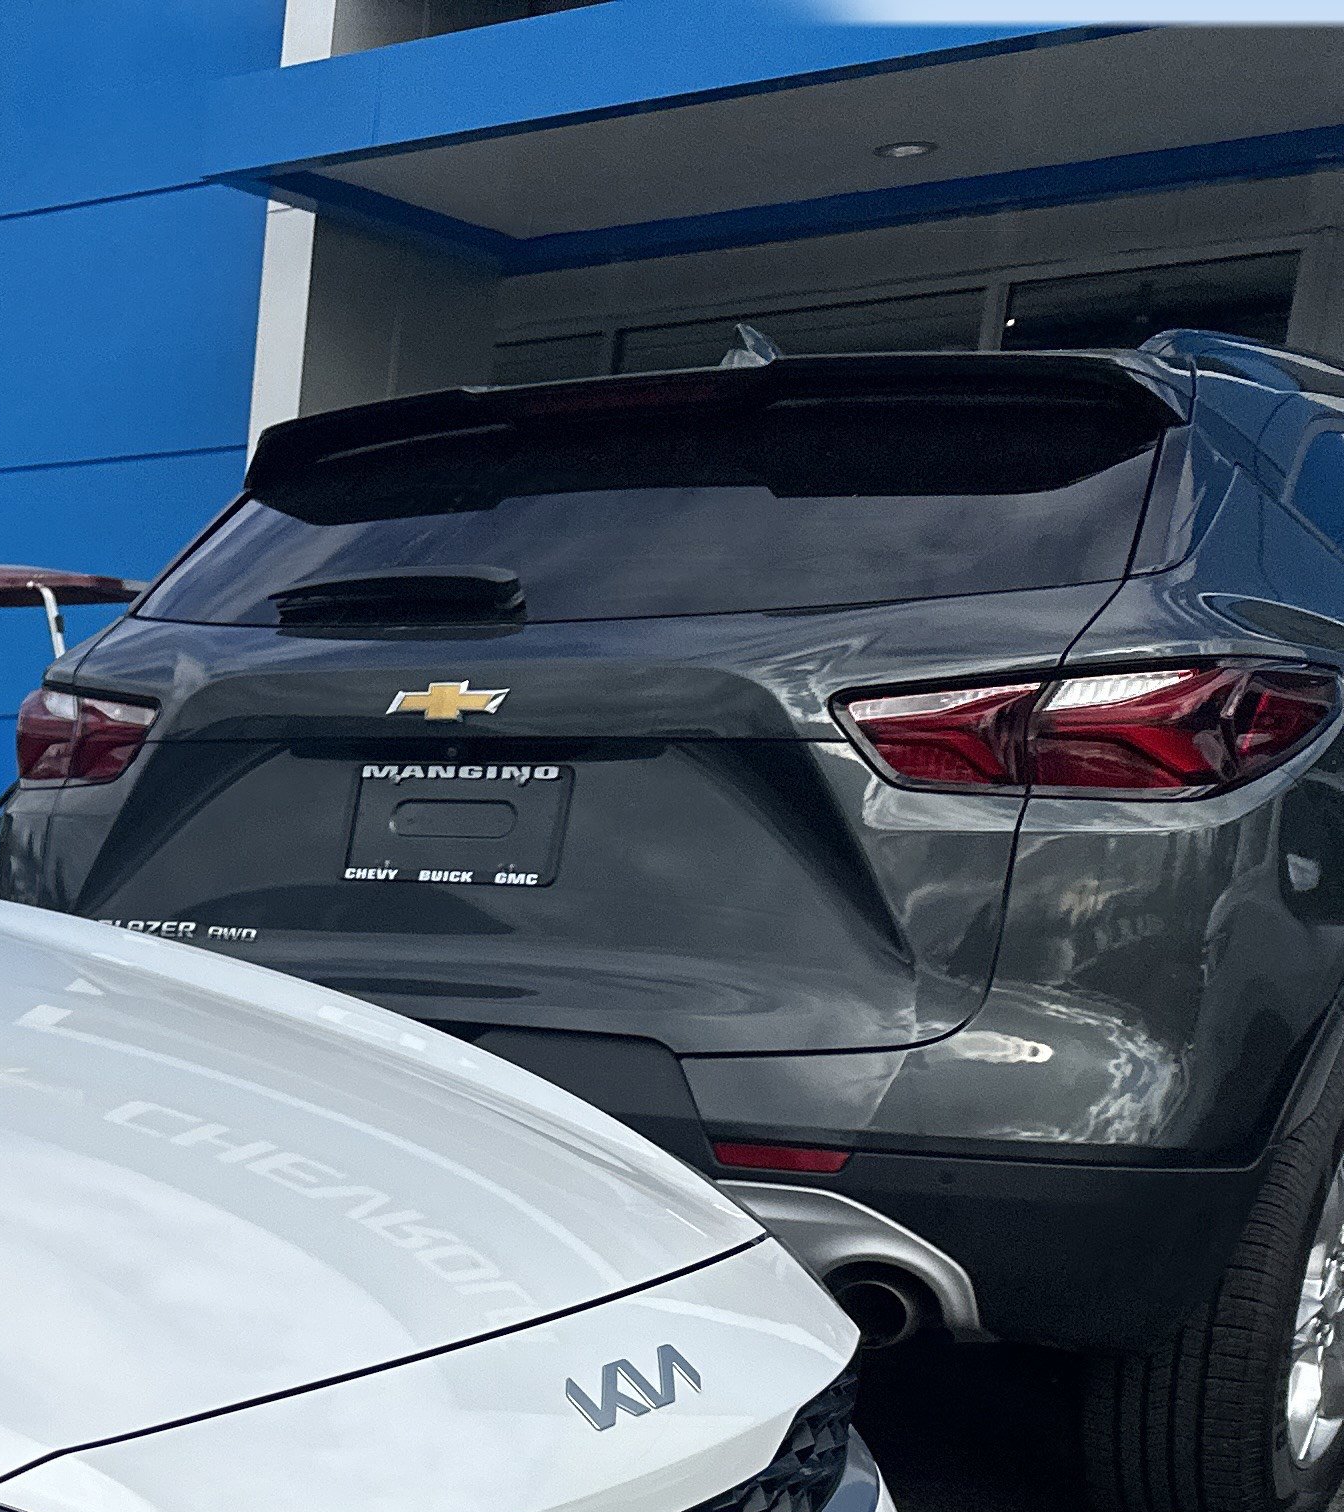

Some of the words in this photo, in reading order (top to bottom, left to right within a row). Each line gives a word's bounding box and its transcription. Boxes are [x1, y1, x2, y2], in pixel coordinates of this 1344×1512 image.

[361, 764, 561, 782] MANGINO
[344, 867, 399, 881] CHEVY
[417, 869, 473, 884] BUICK
[494, 872, 539, 886] GMC
[208, 925, 258, 942] AWD
